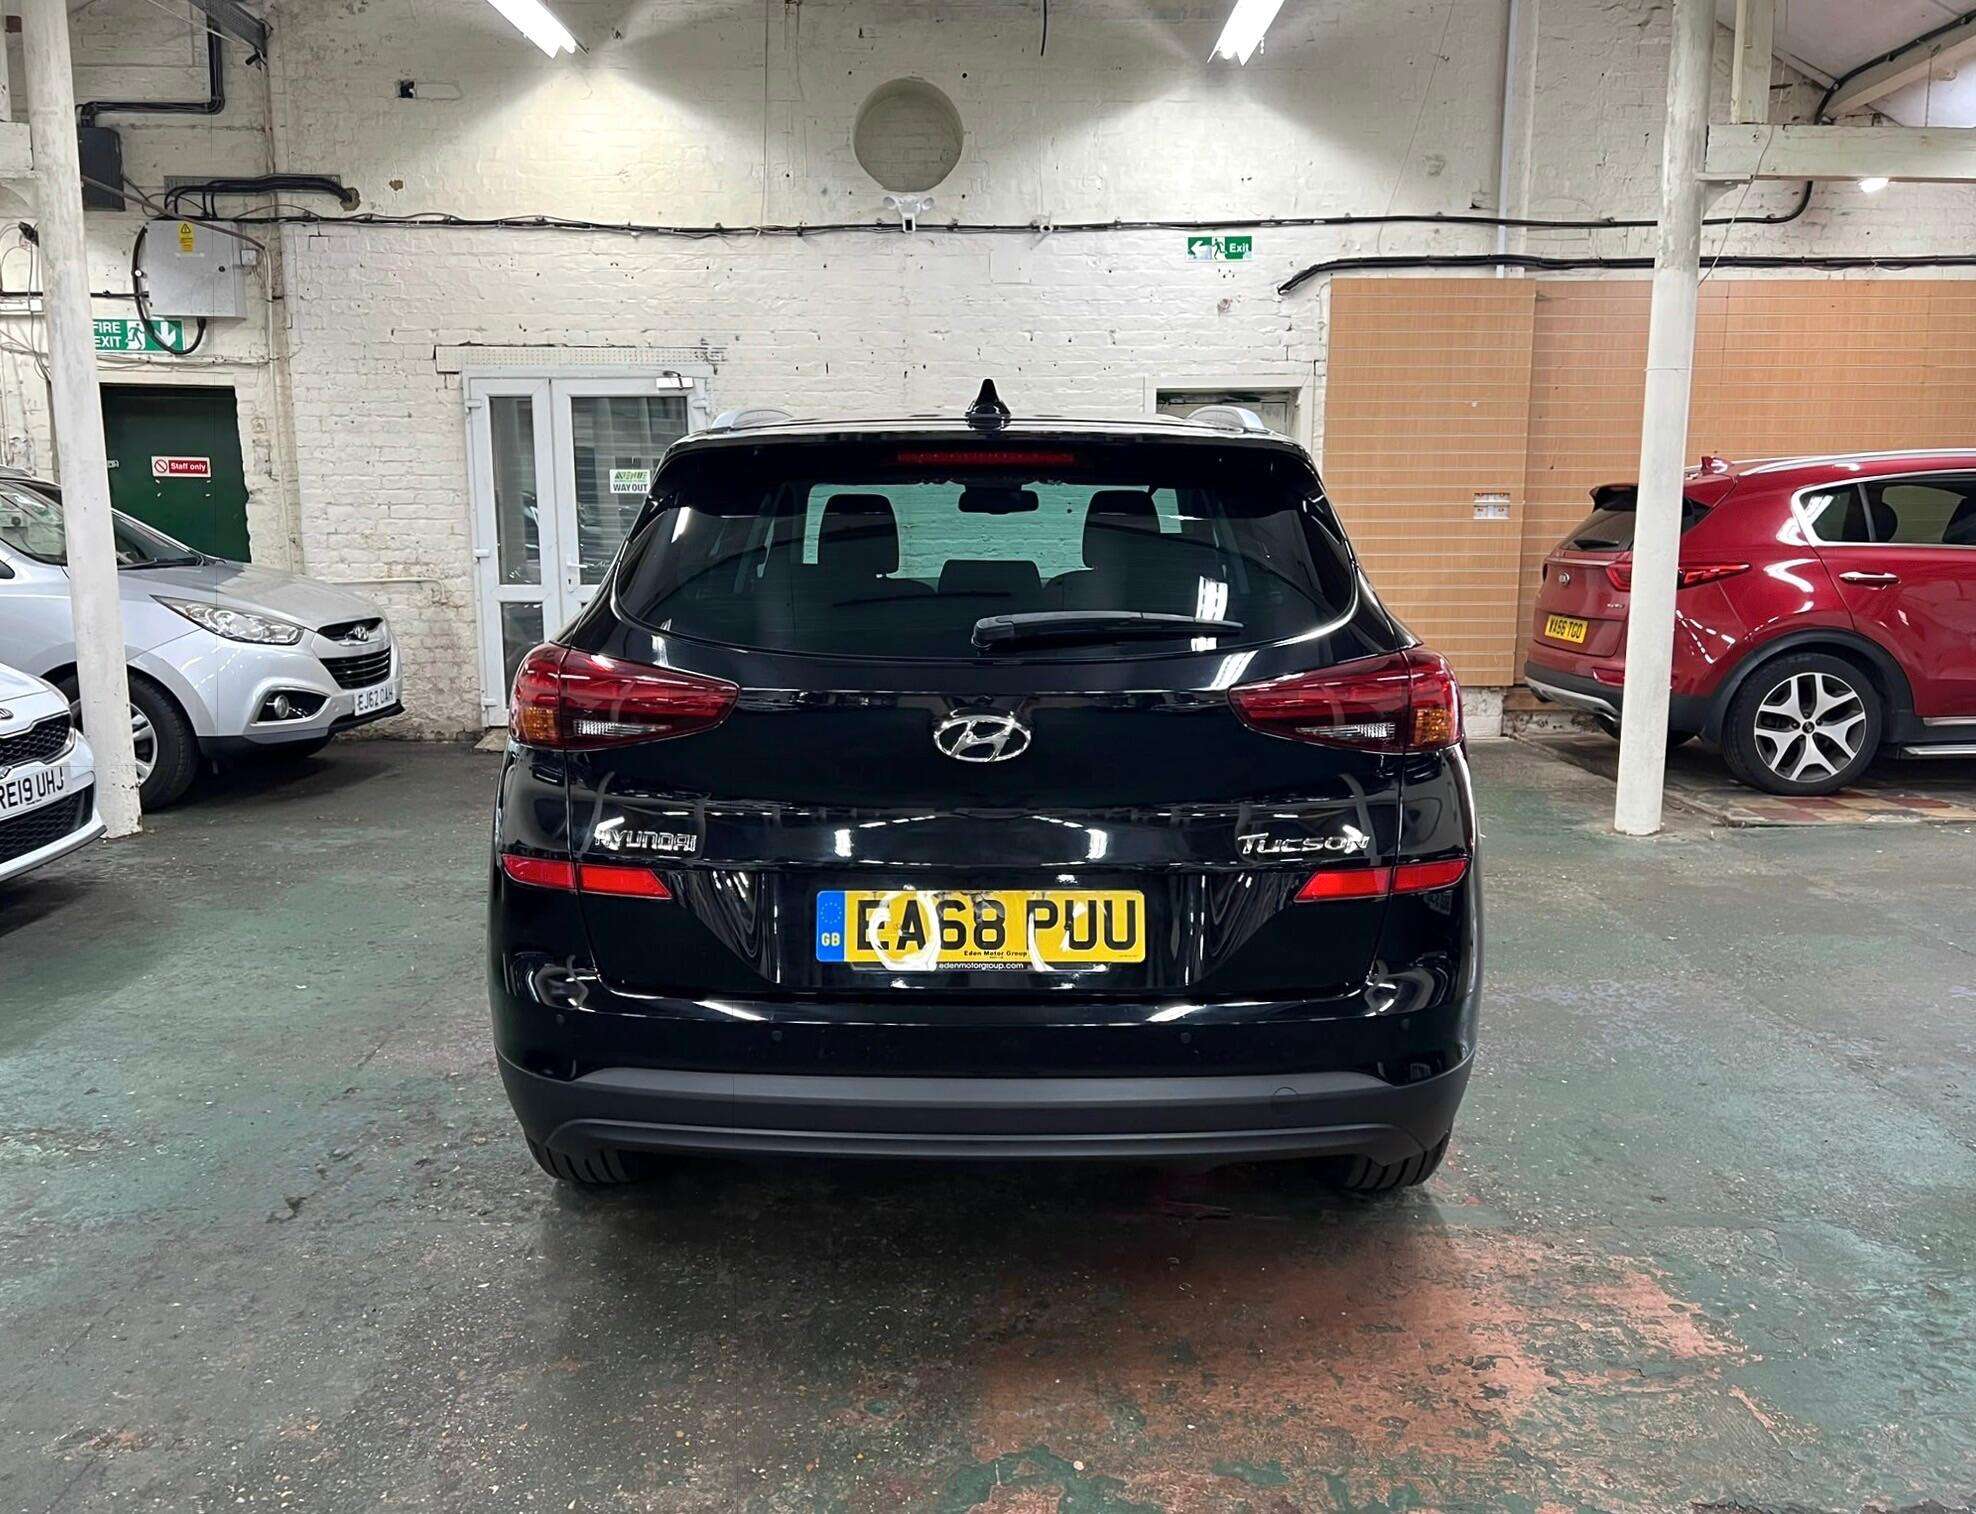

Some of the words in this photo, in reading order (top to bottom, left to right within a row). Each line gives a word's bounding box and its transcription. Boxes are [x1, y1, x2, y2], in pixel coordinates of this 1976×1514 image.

[1229, 242, 1249, 253] Exit
[93, 321, 121, 334] FIRE
[94, 336, 121, 348] EXIT
[170, 462, 188, 471] Staff
[189, 463, 206, 472] only
[613, 483, 630, 491] WAY
[631, 483, 648, 491] OUT
[0, 778, 34, 809] RE19
[35, 766, 65, 796] UHJ
[857, 899, 1006, 951] EA68
[1026, 899, 1136, 951] PUU
[821, 932, 841, 947] GB
[1006, 950, 1028, 958] Group
[938, 962, 1024, 971] edenmotorgroup.com
